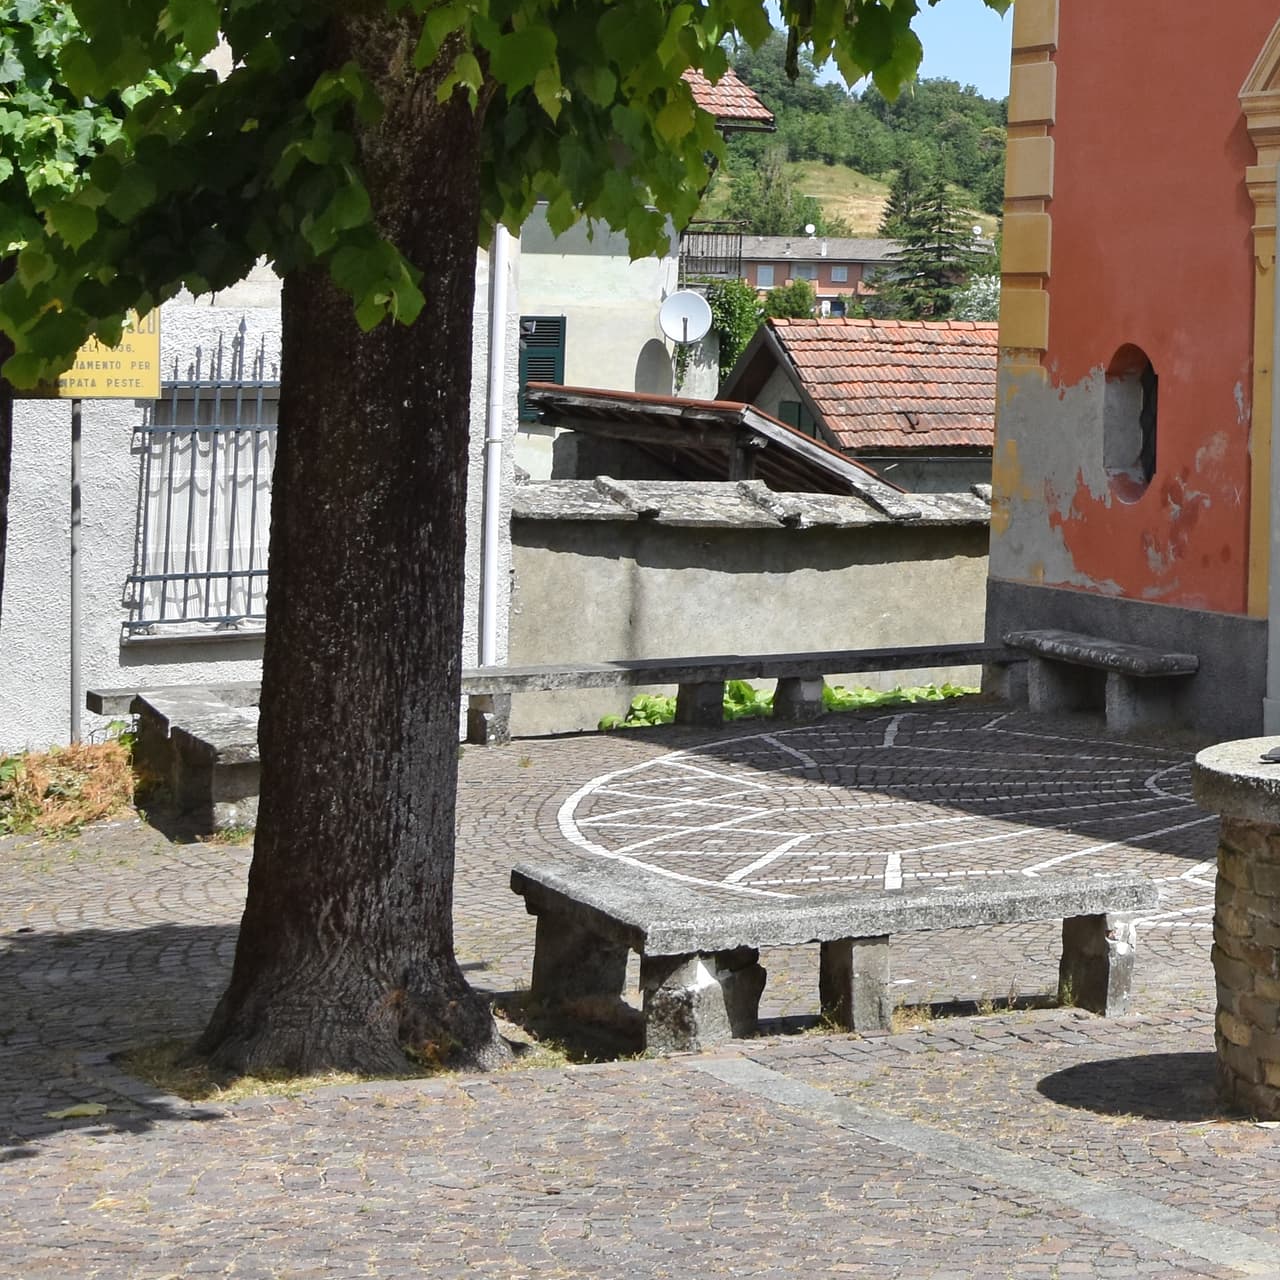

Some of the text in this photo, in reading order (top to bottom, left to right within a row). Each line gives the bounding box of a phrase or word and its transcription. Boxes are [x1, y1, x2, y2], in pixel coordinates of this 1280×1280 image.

[75, 360, 151, 370] IAMENTO PER
[57, 378, 97, 388] MPATA
